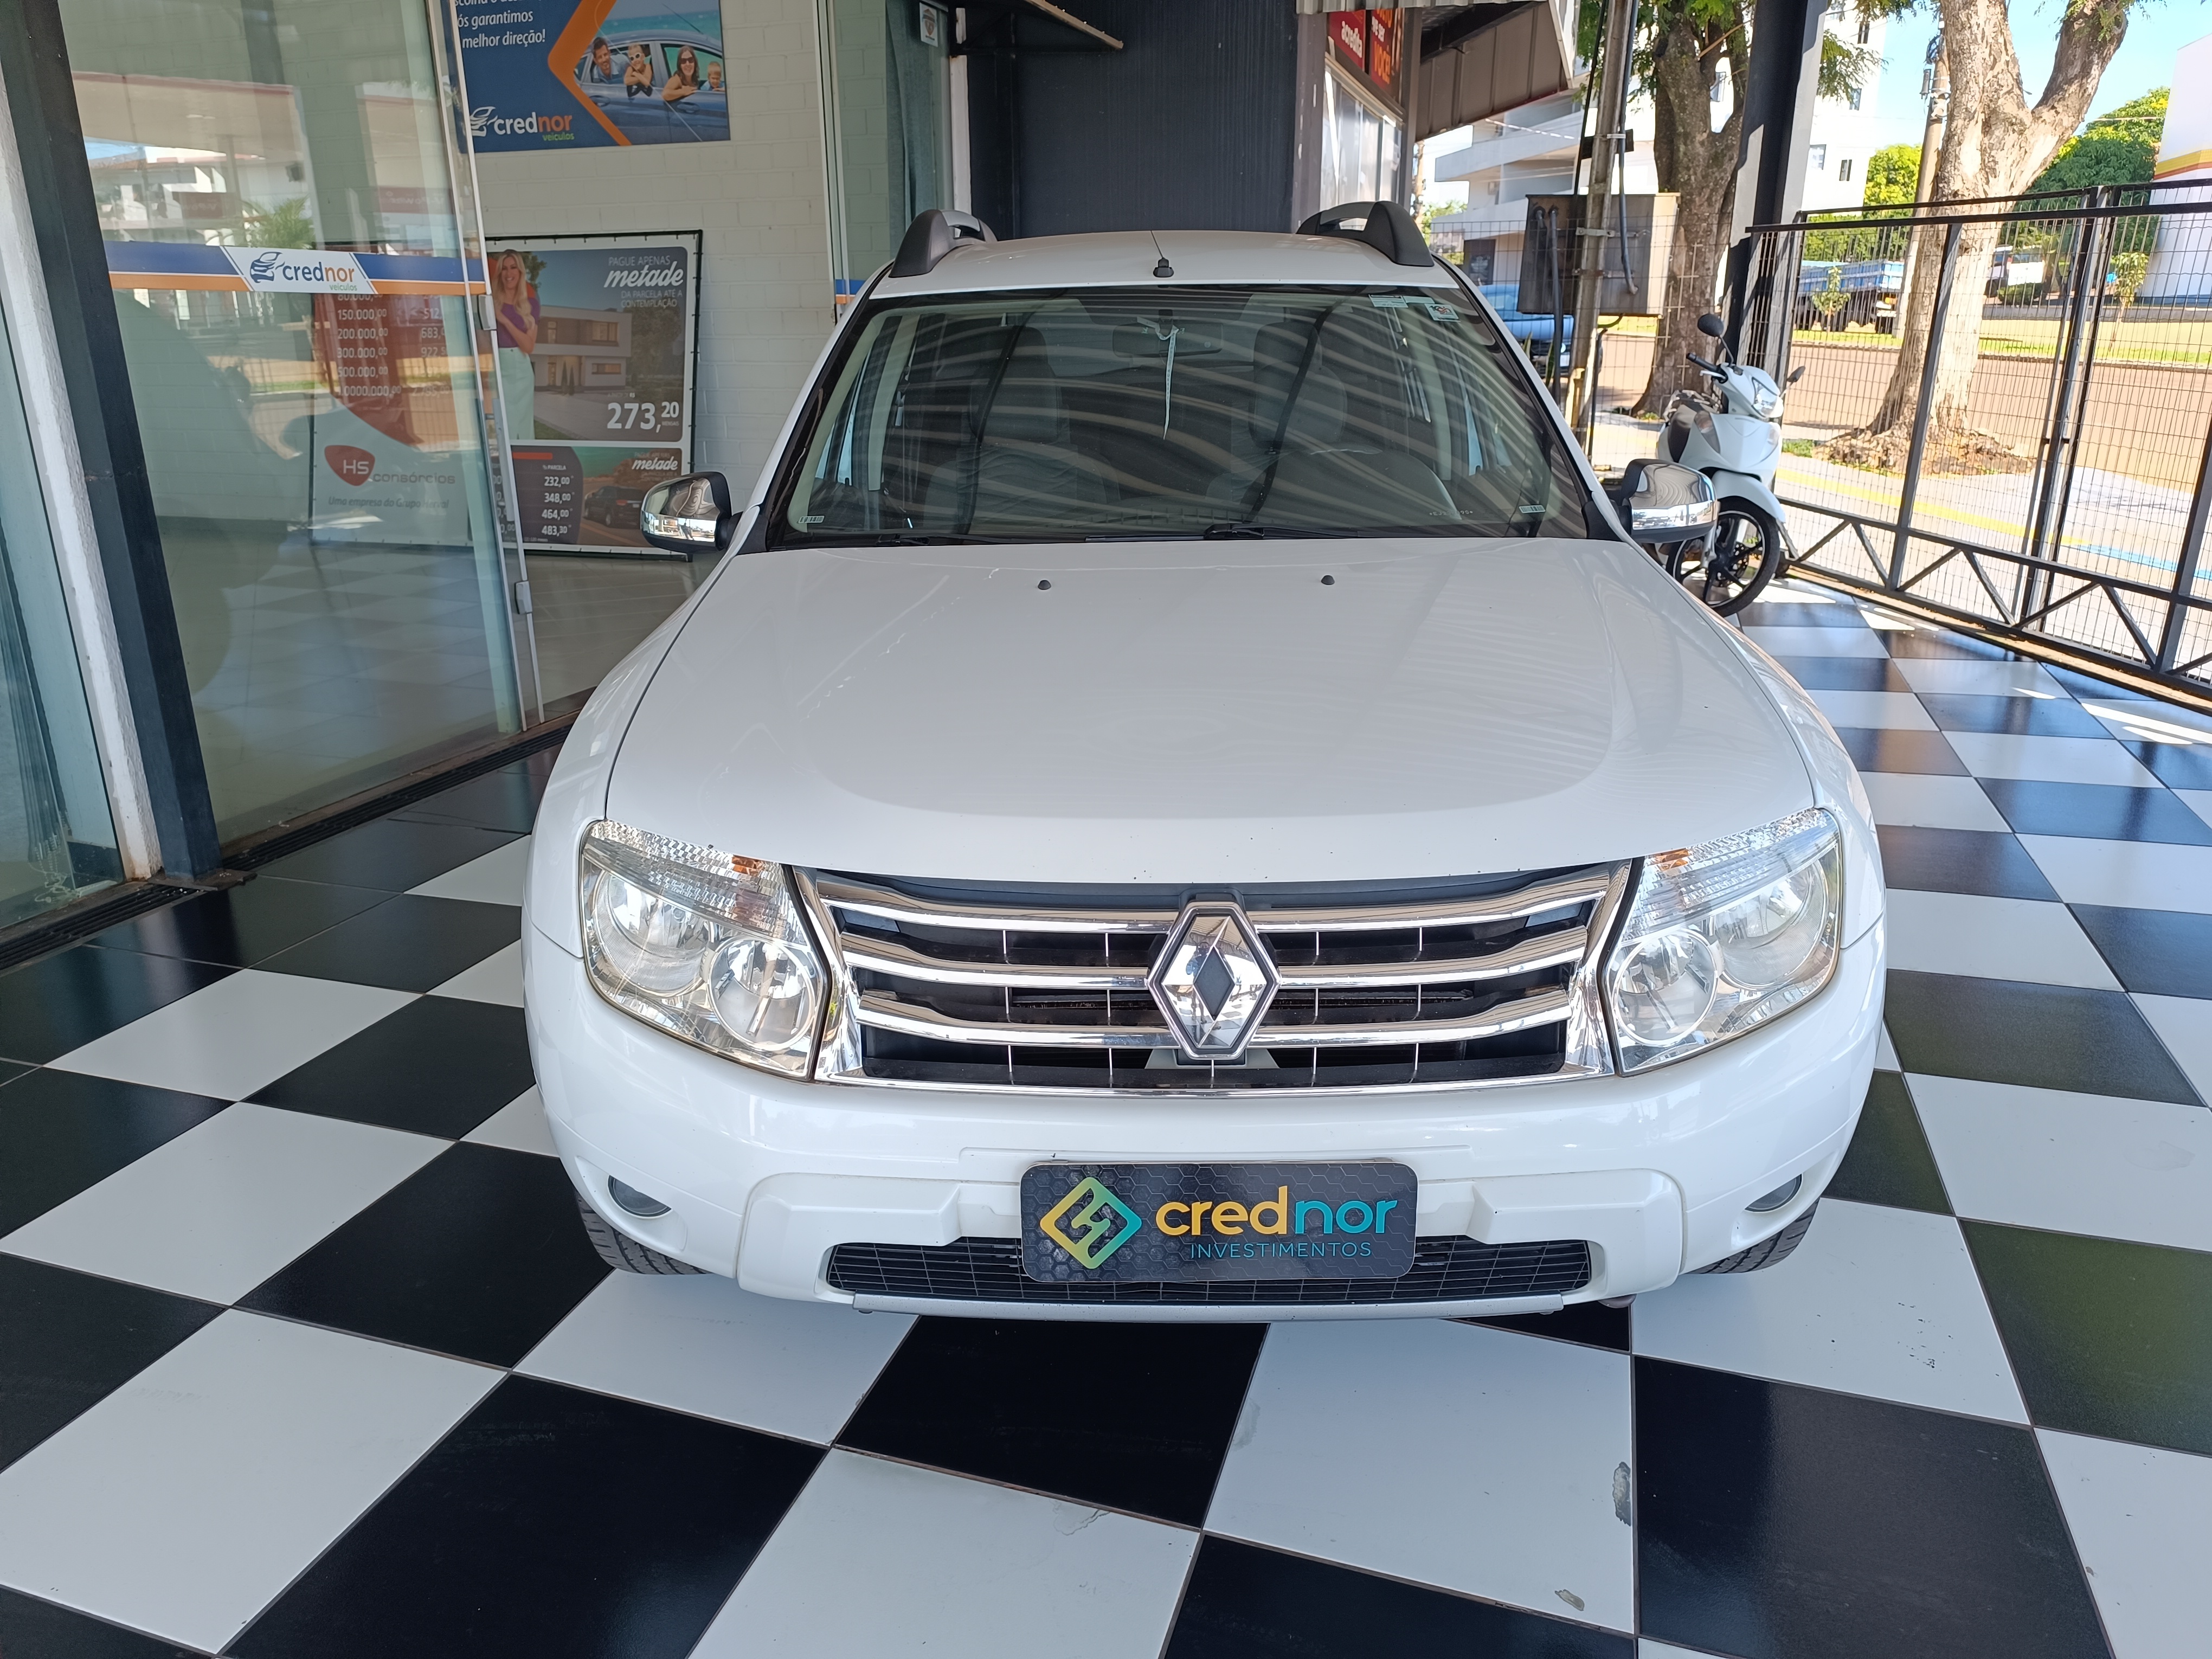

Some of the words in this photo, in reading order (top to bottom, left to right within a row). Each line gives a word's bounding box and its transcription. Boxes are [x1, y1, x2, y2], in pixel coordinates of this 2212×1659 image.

[472, 10, 533, 30] garantimos
[462, 33, 500, 48] melhor
[502, 29, 546, 47] direção!
[493, 112, 573, 135] crednor
[608, 256, 635, 266] PAGUE
[637, 255, 671, 266] APENAS
[282, 261, 355, 282] crednor
[603, 261, 684, 288] metade
[621, 290, 631, 299] DA
[632, 290, 662, 298] PARCELA
[664, 288, 676, 298] ATÉ
[678, 290, 683, 298] A
[621, 299, 678, 309] CONTEMPLAÇÃO
[337, 308, 387, 321] 150.000,00
[337, 327, 388, 340] 200.000,00
[337, 348, 388, 359] 300.000,00
[337, 366, 388, 378] 500.000,00
[343, 459, 369, 474] HS
[632, 456, 678, 471] metade
[372, 472, 456, 484] consórcios
[328, 496, 347, 505] Uma
[348, 498, 382, 508] empresa
[383, 497, 395, 506] do
[395, 498, 421, 509] Grupo
[1155, 1185, 1398, 1236] crednor
[1191, 1242, 1371, 1258] INVESTIMENTOS
